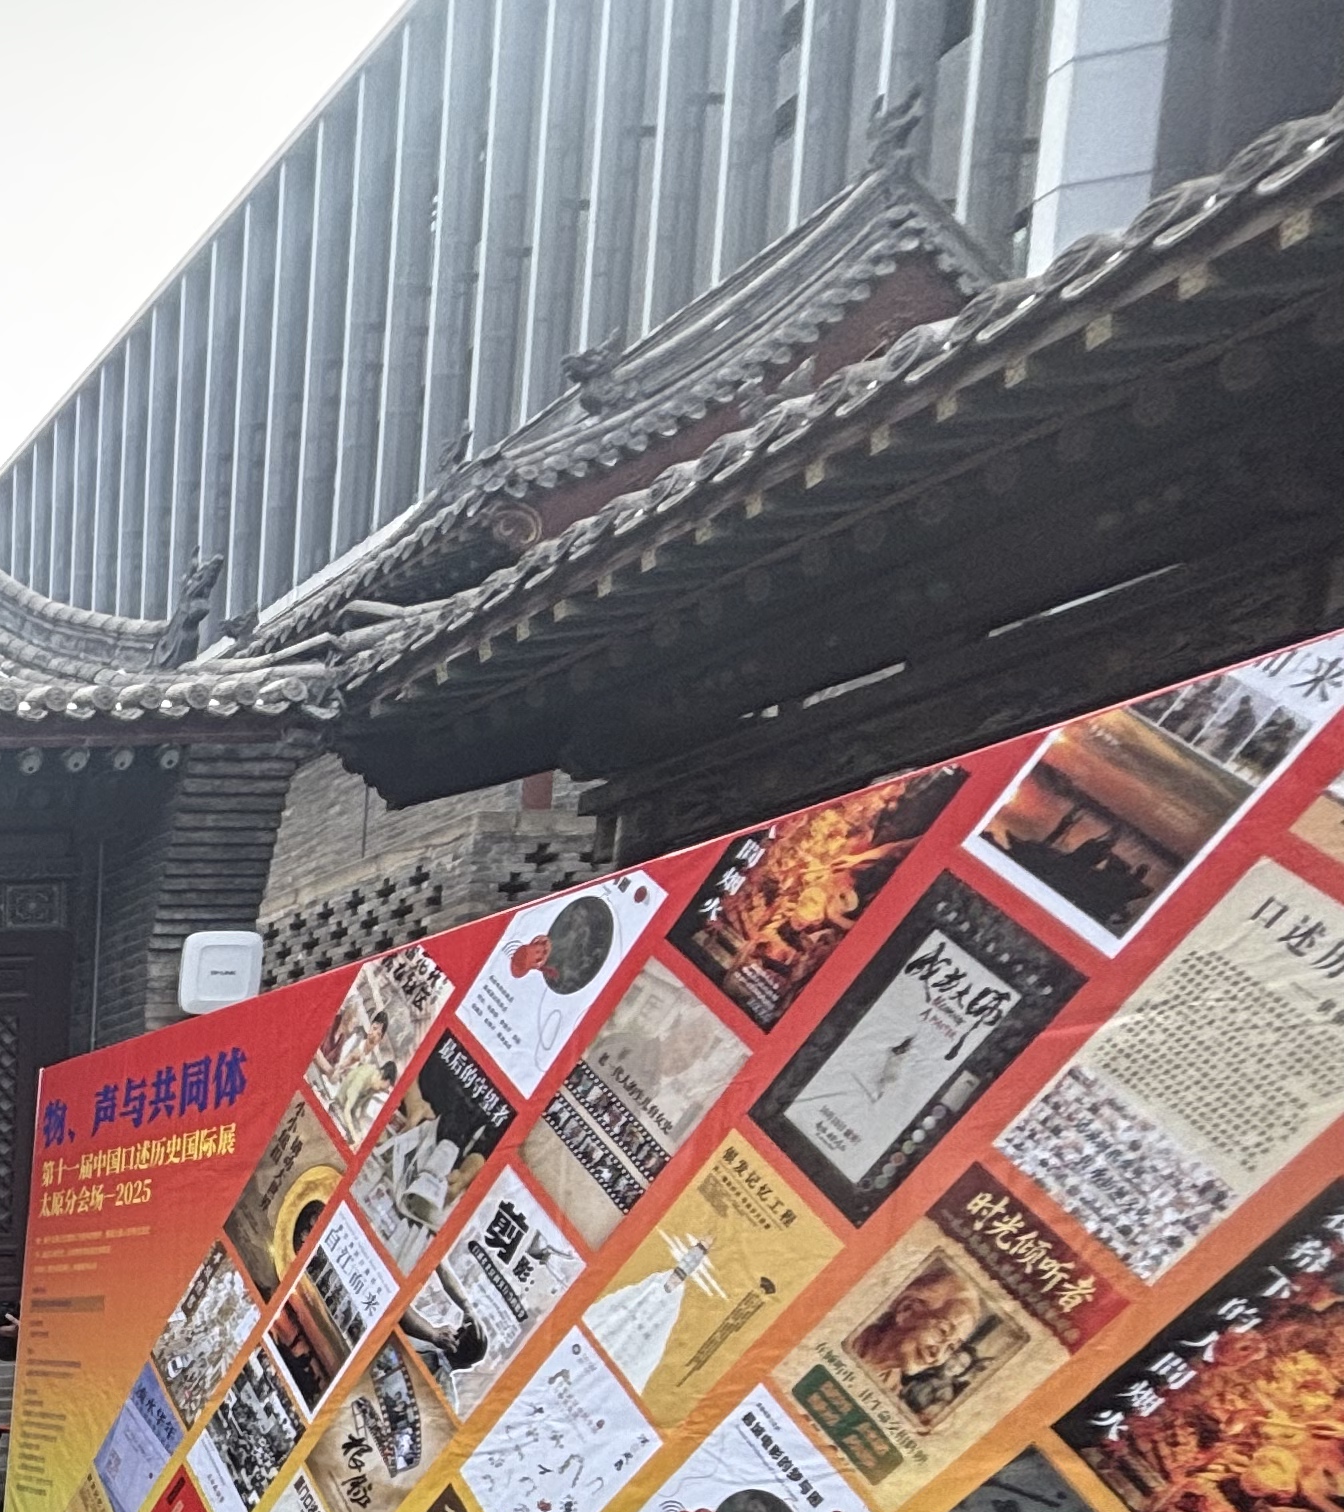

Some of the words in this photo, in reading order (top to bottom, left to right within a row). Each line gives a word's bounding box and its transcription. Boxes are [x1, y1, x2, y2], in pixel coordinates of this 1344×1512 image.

[43, 1047, 248, 1149] 物、声与共同体
[439, 1038, 510, 1128] 最后的守望者
[41, 1123, 236, 1187] 第十一届中国口述历史国际展
[324, 1224, 379, 1316] 自江而来
[966, 1191, 1096, 1313] 时光倾听者
